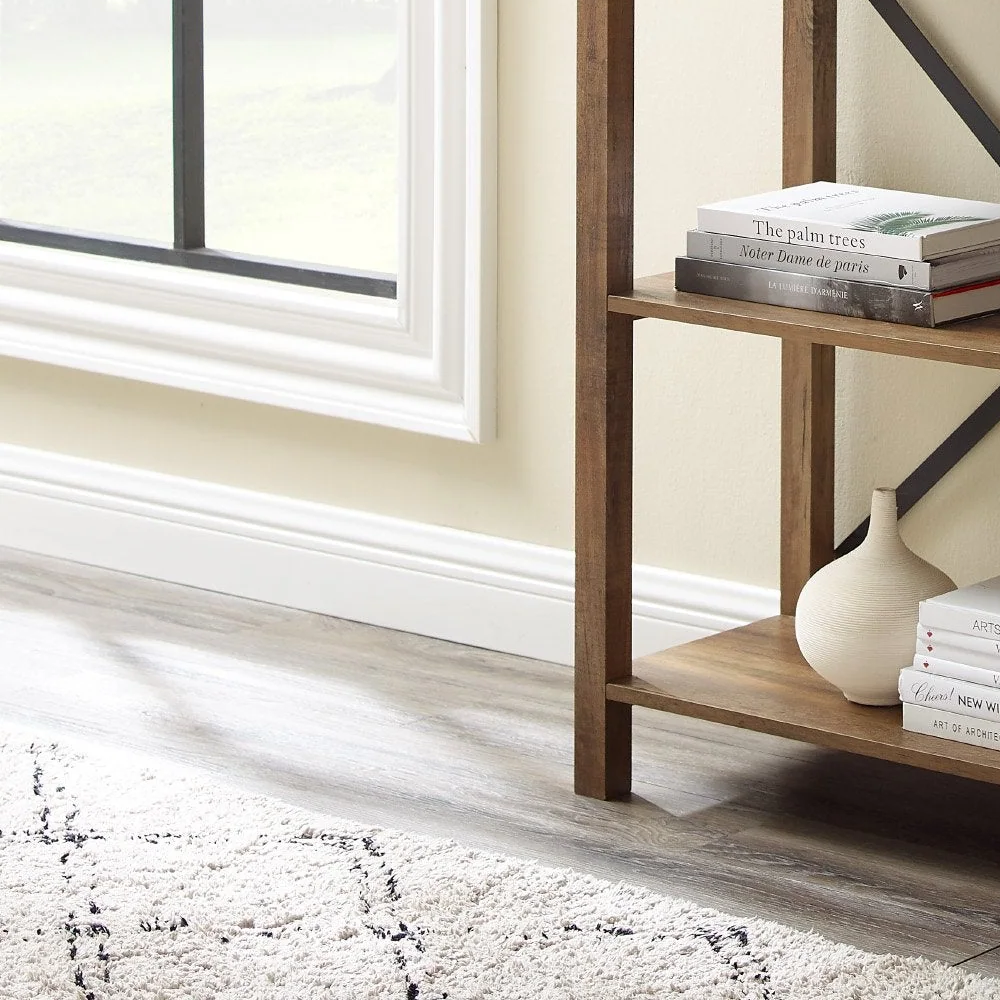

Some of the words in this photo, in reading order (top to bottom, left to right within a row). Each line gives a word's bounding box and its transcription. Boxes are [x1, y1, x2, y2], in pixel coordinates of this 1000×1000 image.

[752, 219, 783, 238] The
[787, 226, 824, 244] palm
[829, 234, 866, 249] trees
[739, 244, 774, 261] Noter
[777, 250, 813, 266] Dame
[816, 256, 831, 269] de
[833, 260, 870, 274] paris
[768, 281, 777, 289] LA
[958, 694, 984, 710] NEW
[933, 719, 948, 730] ART
[952, 723, 962, 734] OF
